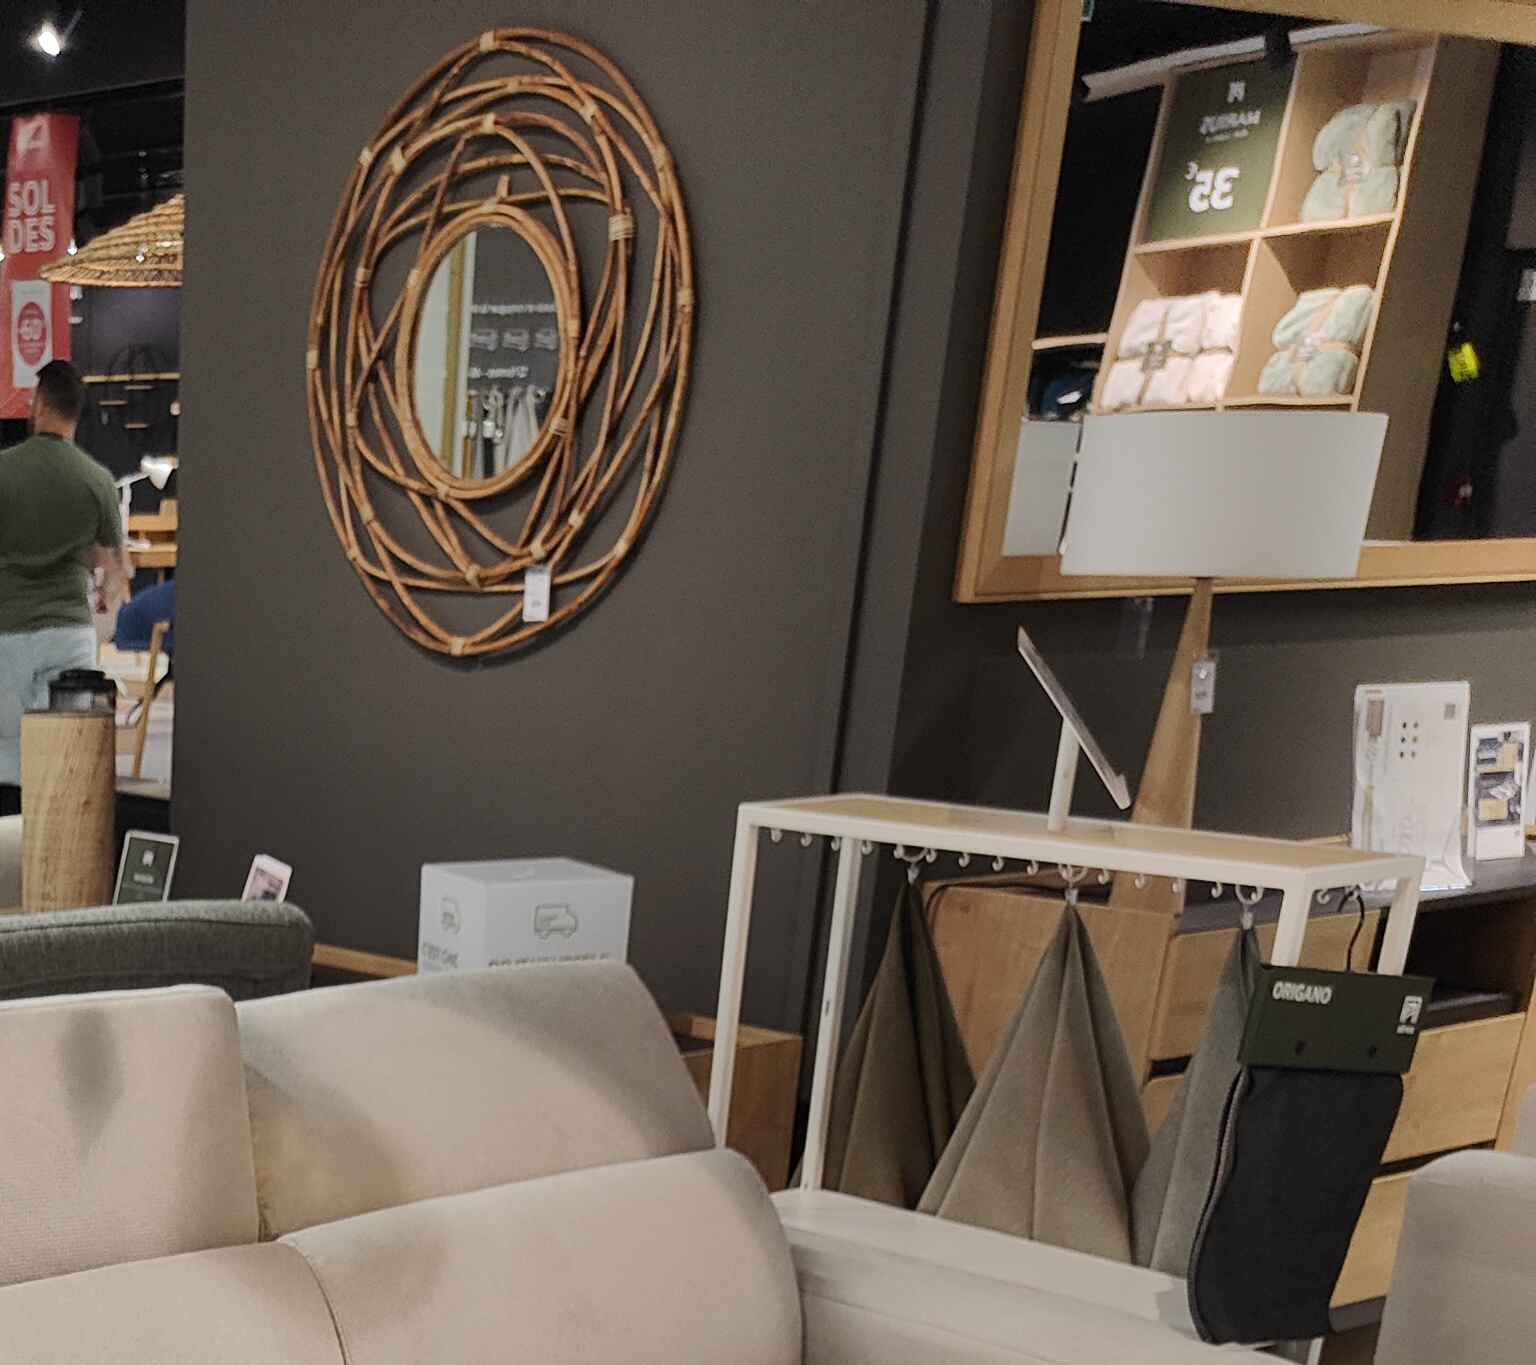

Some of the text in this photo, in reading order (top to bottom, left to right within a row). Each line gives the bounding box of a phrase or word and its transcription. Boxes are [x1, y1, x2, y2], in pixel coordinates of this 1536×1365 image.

[7, 179, 56, 217] SOL
[8, 216, 55, 253] DES
[1272, 979, 1333, 1005] ORIGANO
